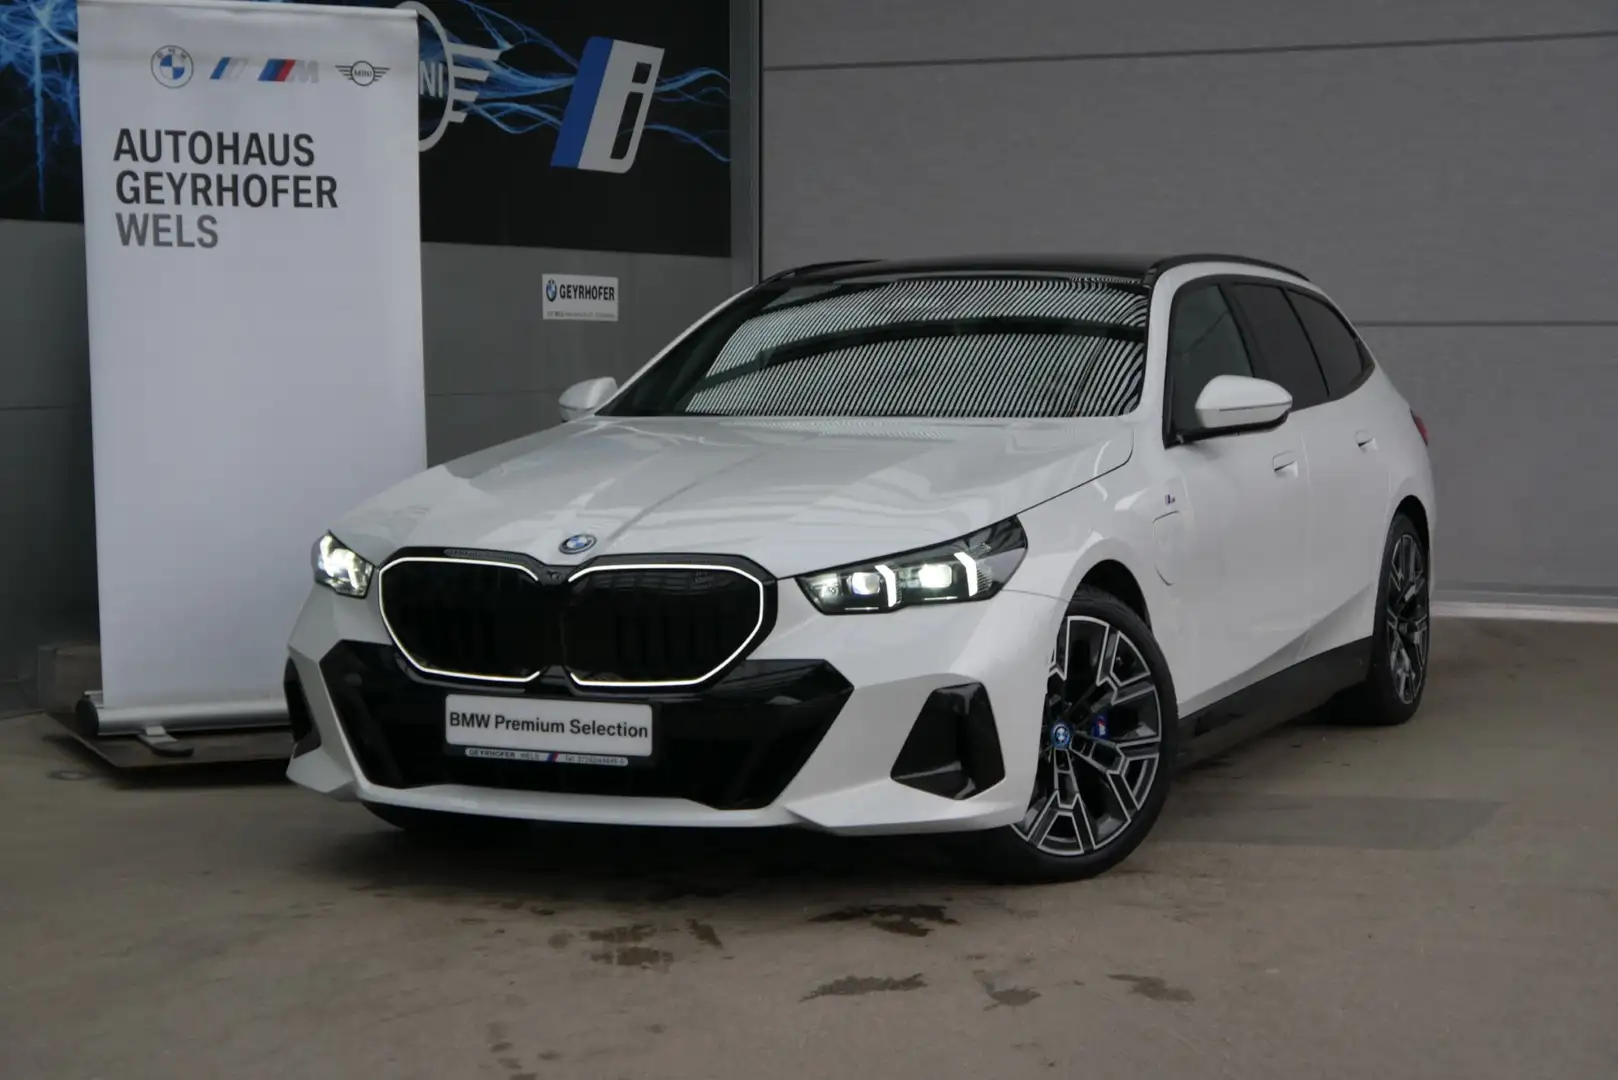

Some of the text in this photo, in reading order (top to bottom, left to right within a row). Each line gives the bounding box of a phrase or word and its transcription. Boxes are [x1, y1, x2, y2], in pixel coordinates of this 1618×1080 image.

[354, 69, 372, 77] MINI
[419, 61, 444, 98] NI
[113, 128, 316, 167] AUTOHAUS
[116, 170, 339, 208] GEYRHOFER
[115, 212, 219, 249] WELS
[559, 284, 615, 301] GEYRHOFER
[449, 711, 649, 738] BMW Premium Selection
